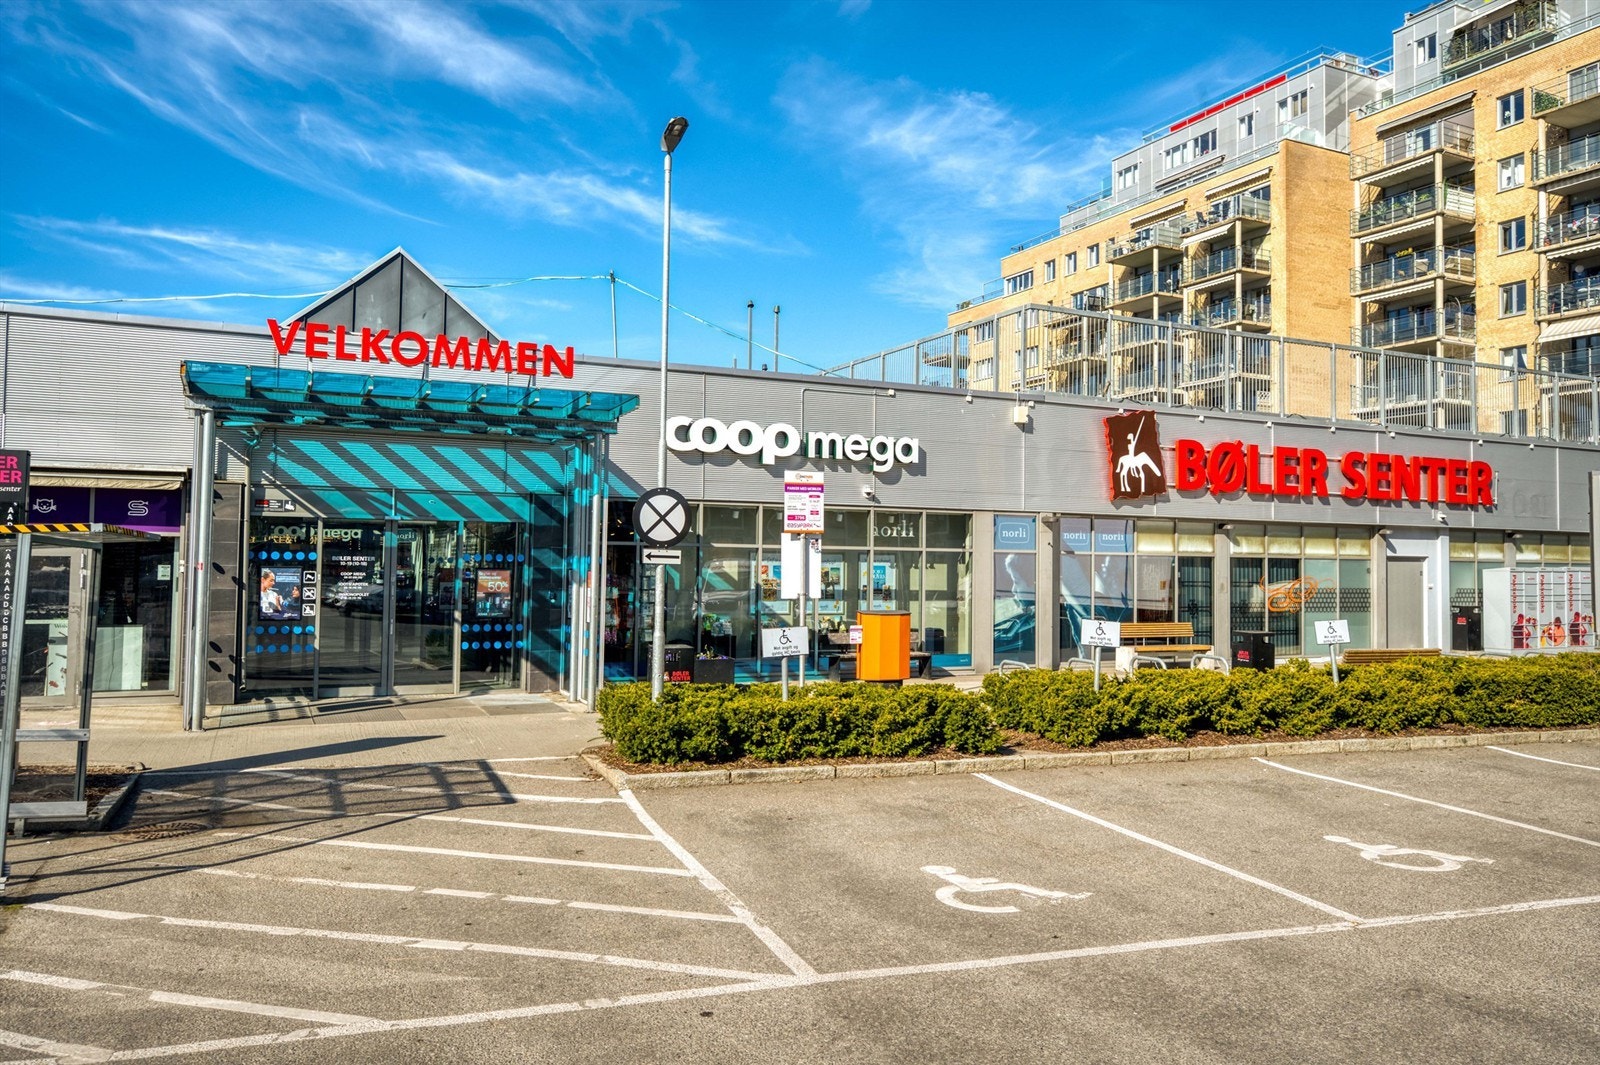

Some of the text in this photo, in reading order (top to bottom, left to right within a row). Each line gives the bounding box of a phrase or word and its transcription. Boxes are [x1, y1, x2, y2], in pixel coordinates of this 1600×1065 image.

[266, 318, 575, 379] VELKOMMEN
[665, 415, 919, 472] coop mega
[1175, 439, 1494, 506] BØLER SENTER
[1002, 528, 1026, 537] norli
